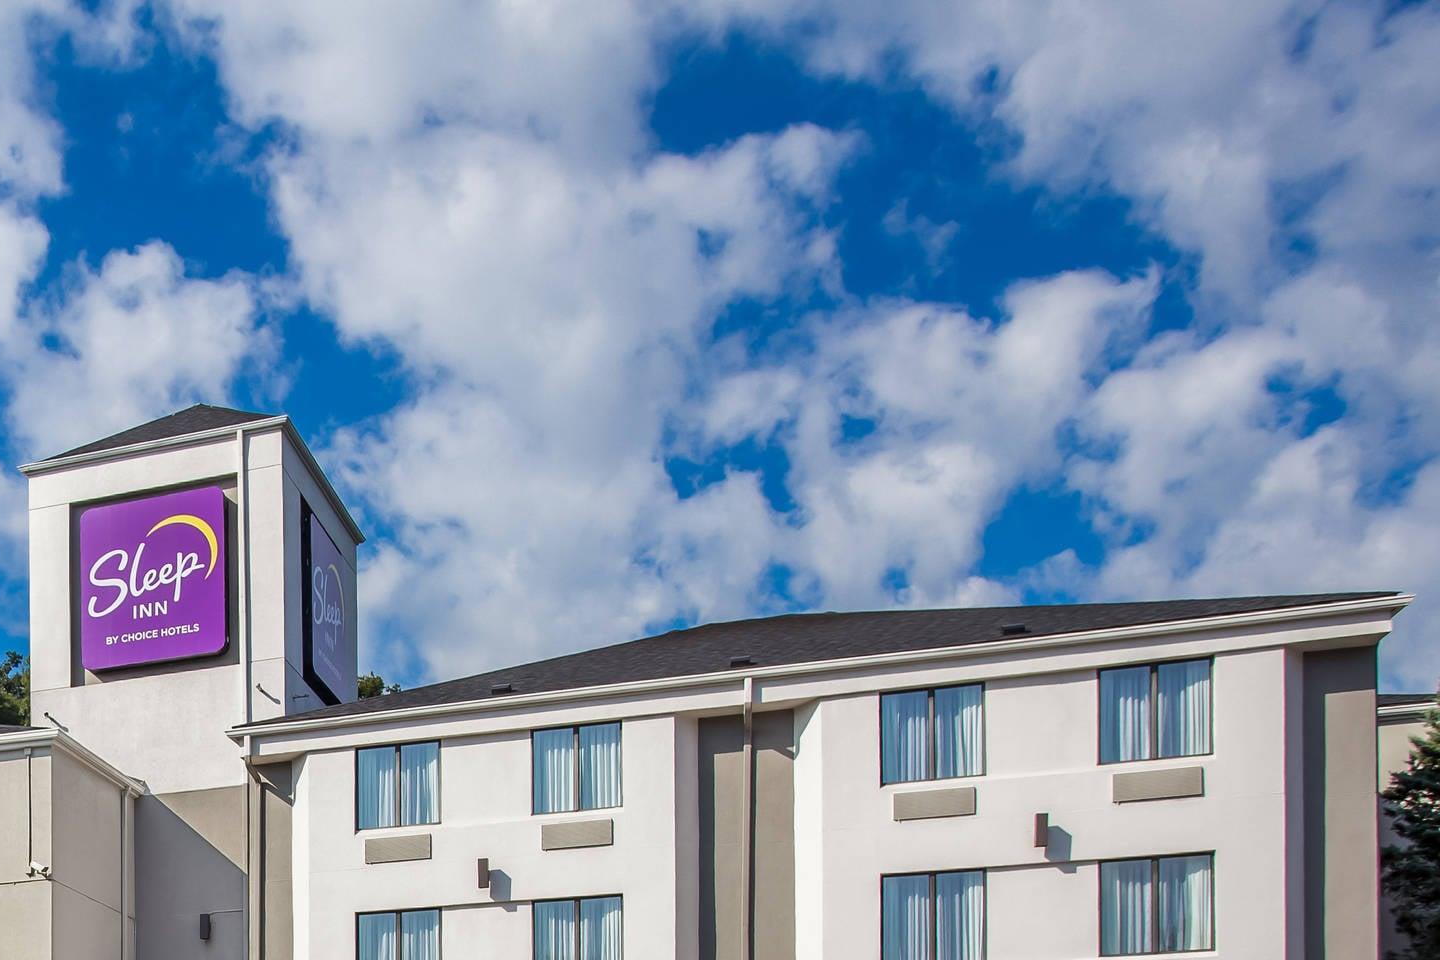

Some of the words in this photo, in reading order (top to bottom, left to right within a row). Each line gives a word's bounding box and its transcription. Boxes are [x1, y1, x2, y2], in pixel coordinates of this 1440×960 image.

[88, 543, 205, 618] Sleep
[133, 600, 168, 619] INN
[313, 566, 342, 646] Sleep
[106, 636, 119, 645] BY
[121, 629, 159, 643] CHOICE
[161, 623, 200, 637] HOTELS
